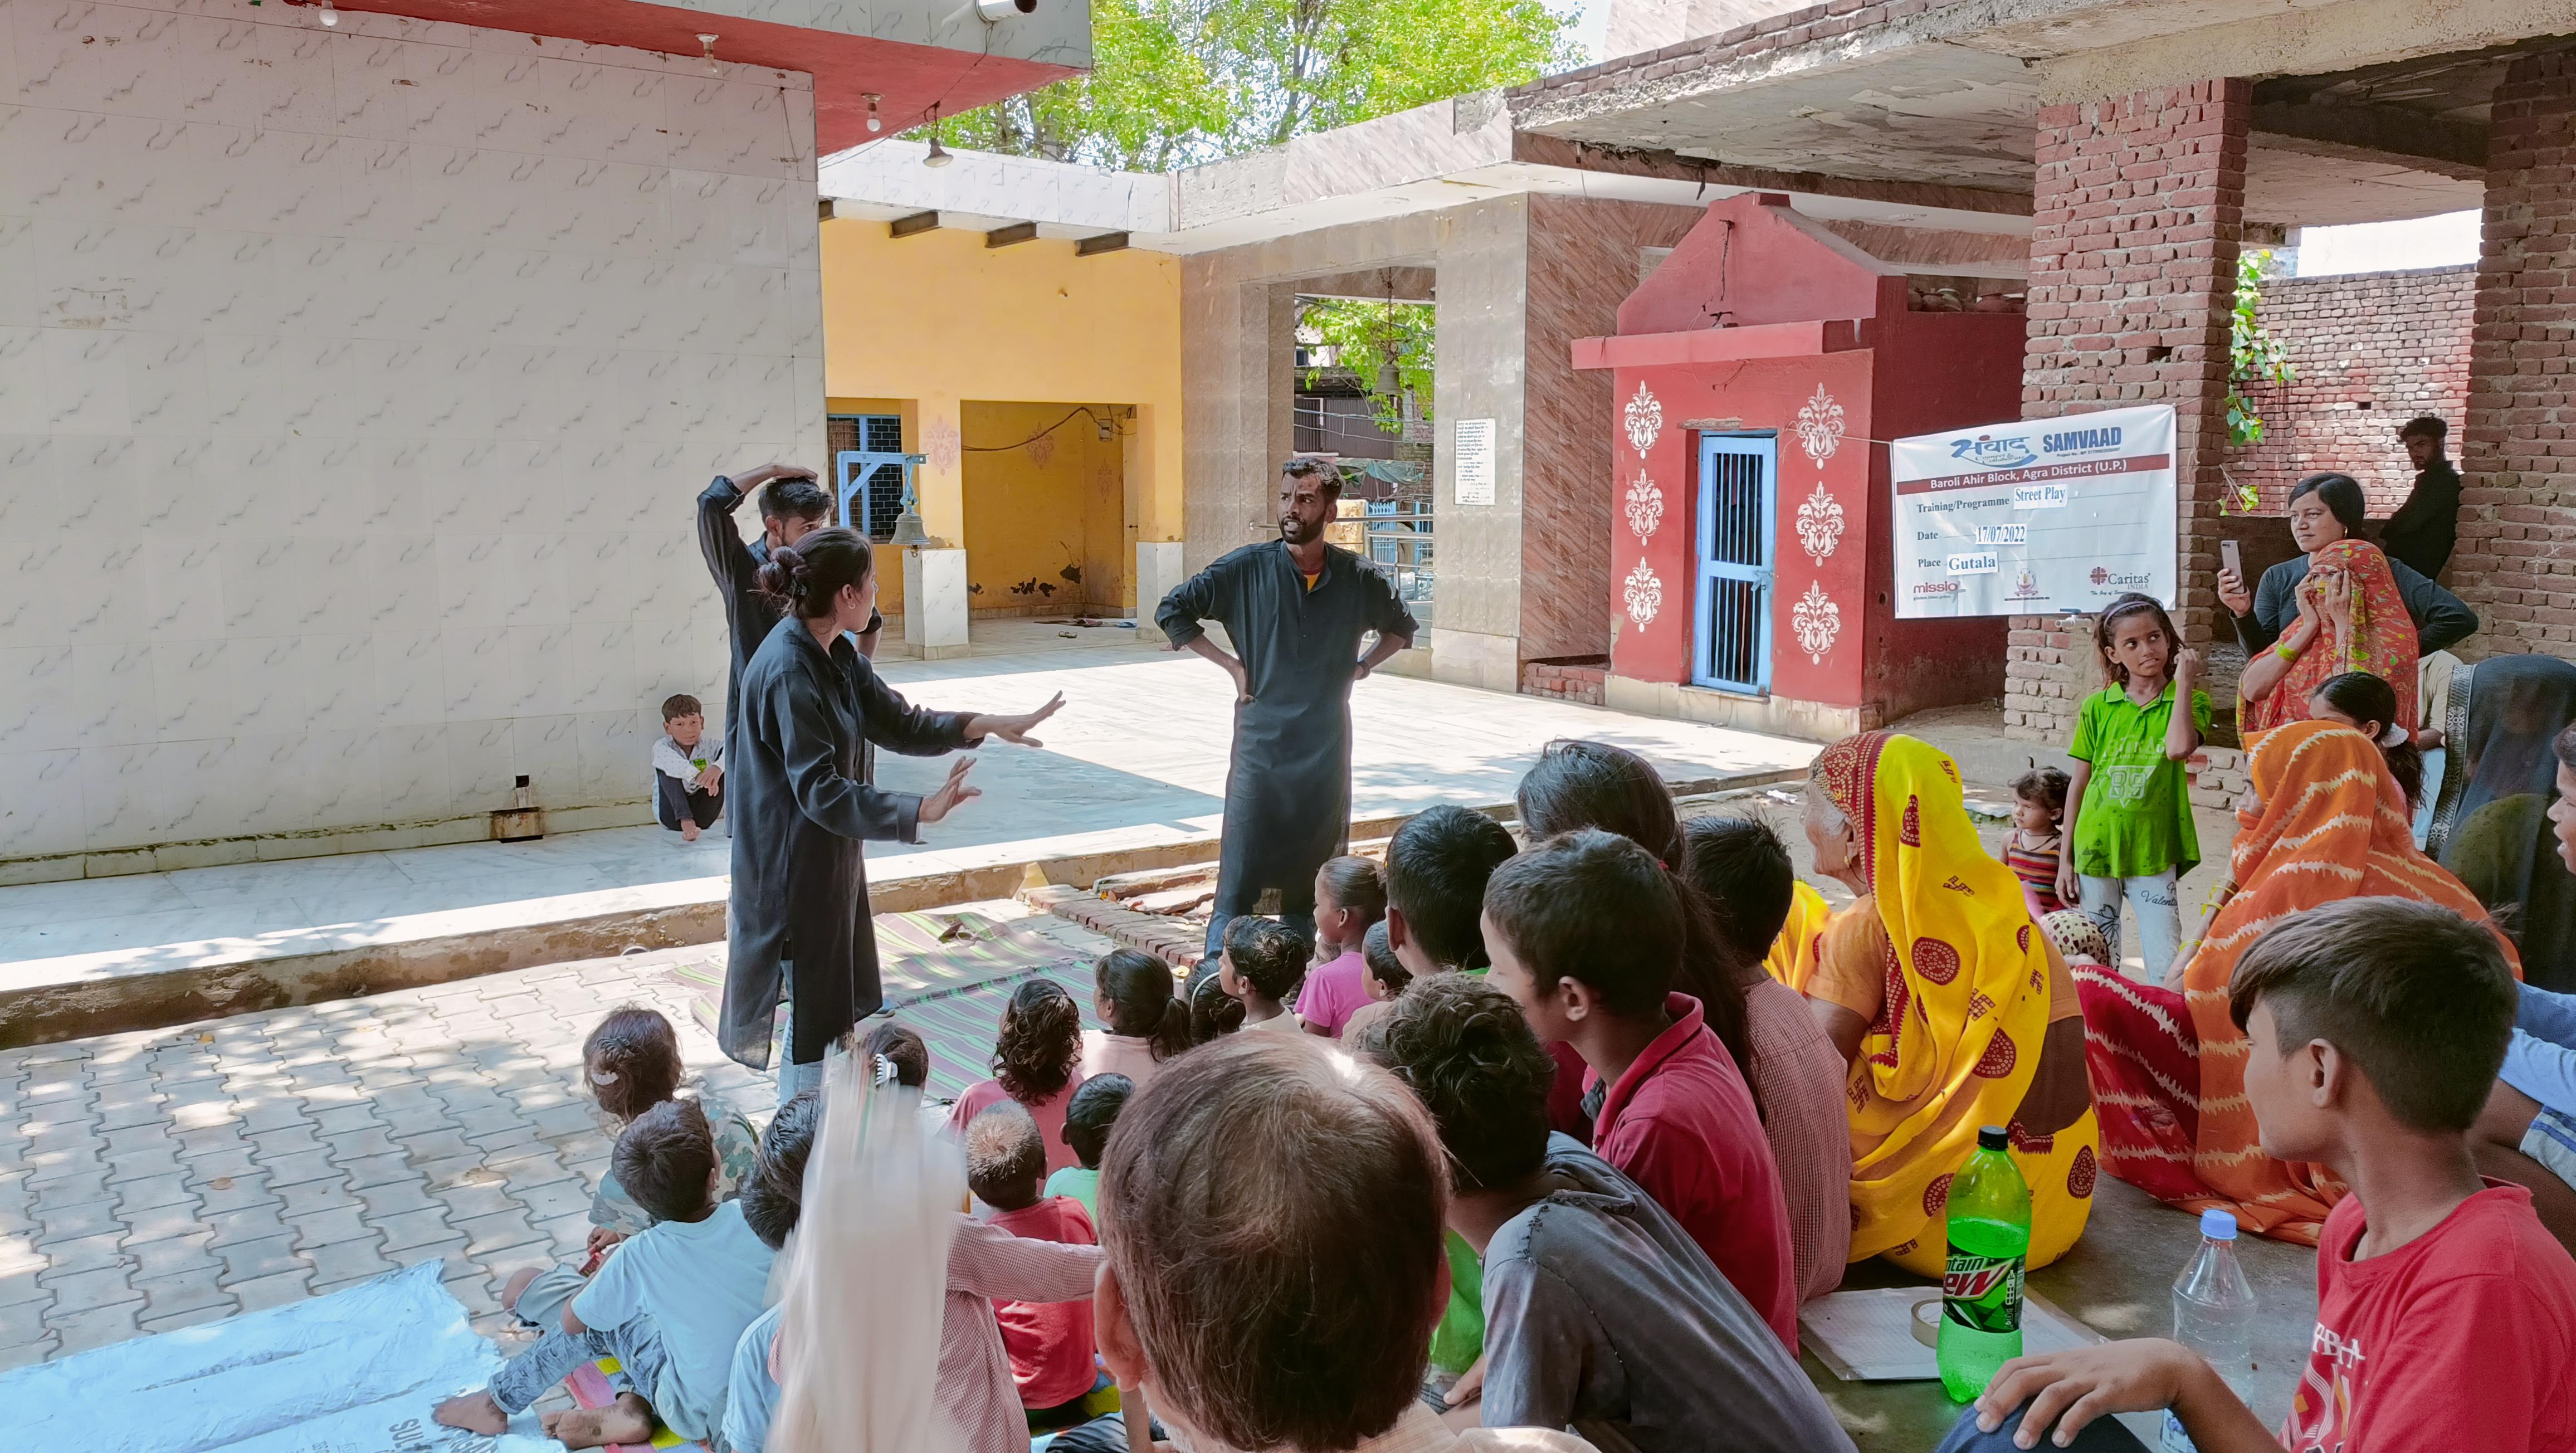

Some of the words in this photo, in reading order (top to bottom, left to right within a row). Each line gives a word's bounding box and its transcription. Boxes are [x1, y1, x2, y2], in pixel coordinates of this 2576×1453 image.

[2043, 427, 2121, 453] SAMVAAD
[1930, 476, 1960, 489] Baroli
[1963, 475, 1984, 486] Ahir
[1988, 469, 2020, 483] Block,
[2022, 469, 2048, 481] Agra
[2051, 463, 2092, 477] District
[2095, 459, 2128, 474] (U.P.)
[1916, 497, 2010, 513] Training/Programme
[2015, 487, 2042, 502] Street
[2045, 486, 2066, 503] Play
[1917, 532, 1939, 540] Date
[1977, 525, 2026, 543] 17/07/2022
[1918, 558, 1941, 567] Place
[1949, 555, 1996, 571] Gutala
[1913, 581, 1958, 593] missio
[2107, 572, 2149, 584] Caritas
[2109, 771, 2146, 799] 89
[1946, 1257, 1984, 1272] ntain
[1943, 1264, 2008, 1296] ew
